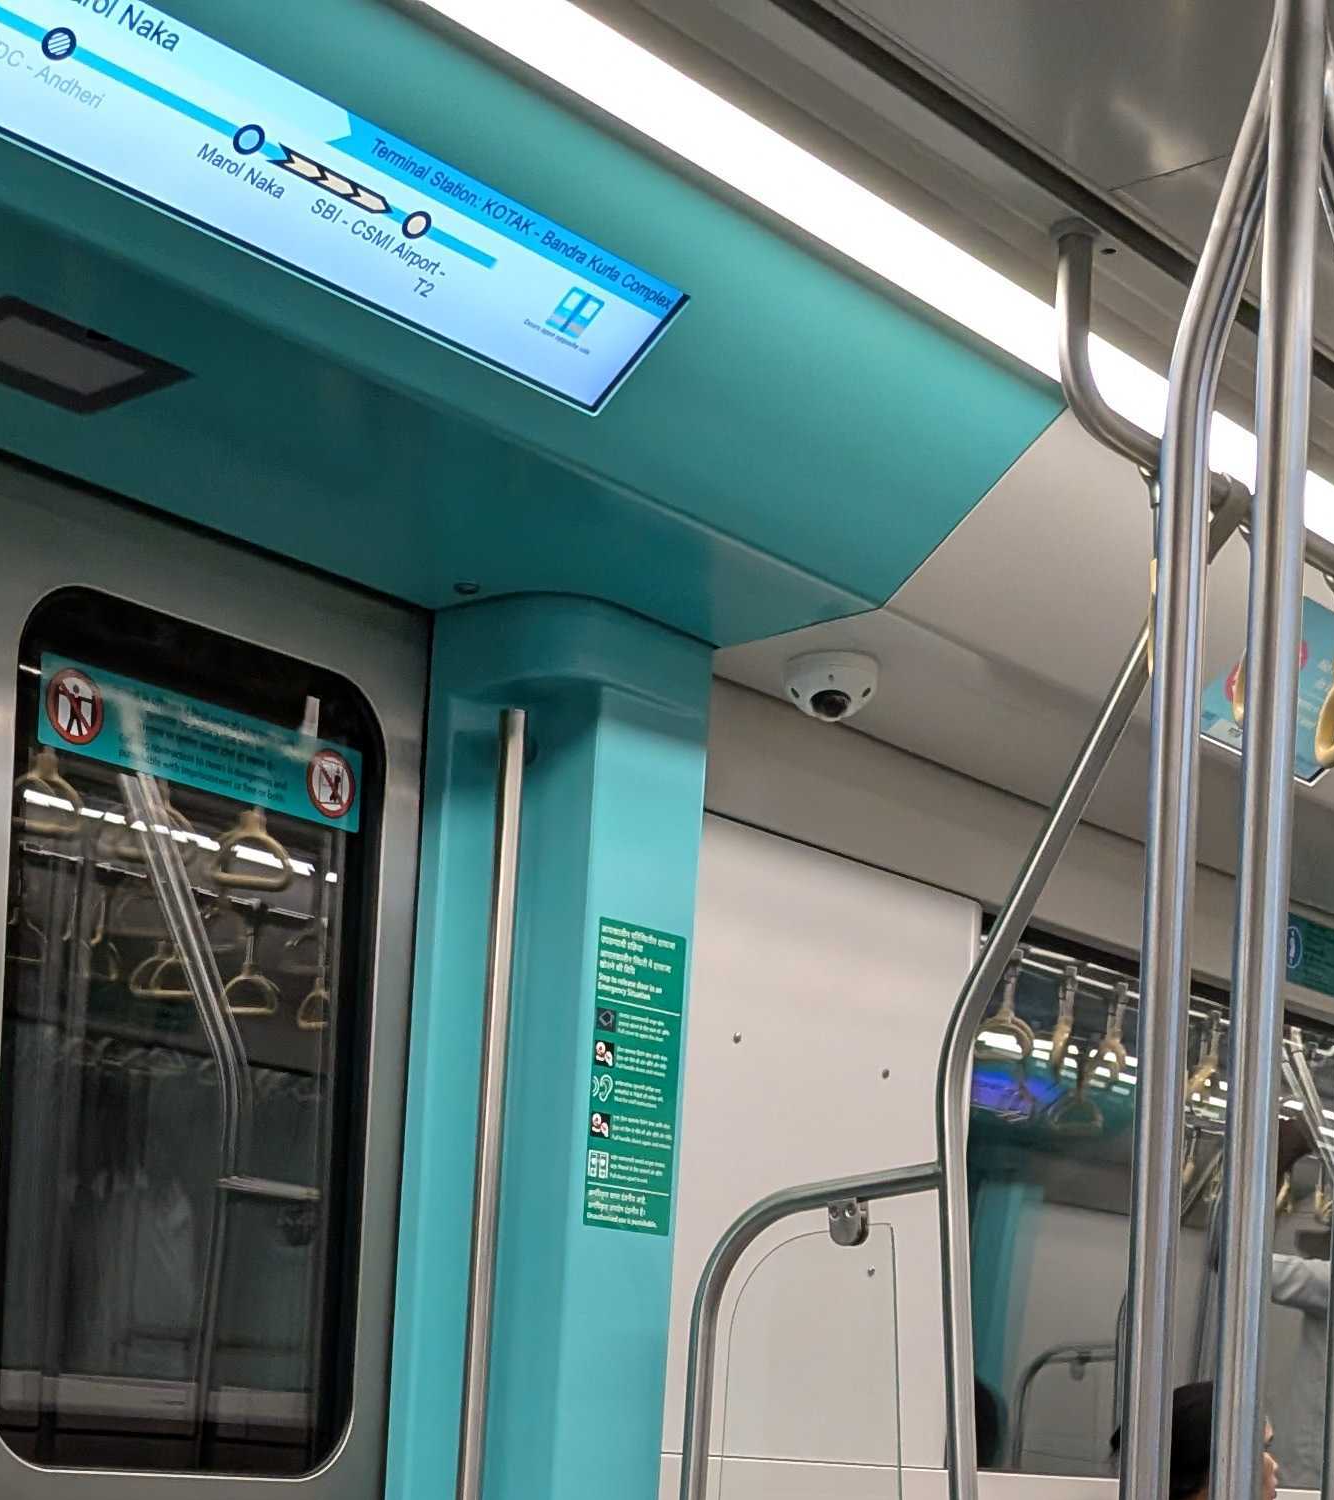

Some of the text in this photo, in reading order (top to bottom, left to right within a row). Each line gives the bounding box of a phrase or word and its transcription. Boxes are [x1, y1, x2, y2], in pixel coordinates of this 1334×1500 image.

[118, 4, 180, 51] Naka
[34, 65, 107, 109] Andheri
[197, 143, 286, 199] Marol Naka
[311, 199, 344, 223] SBI
[351, 219, 394, 250] CSMI
[392, 243, 440, 275] Airport
[370, 138, 431, 180] Terminal
[430, 171, 479, 207] Station:
[482, 199, 537, 236] KOTAK
[540, 230, 589, 264] Bandra
[587, 256, 621, 282] Kurla
[621, 274, 674, 310] Complex
[413, 277, 435, 298] T2
